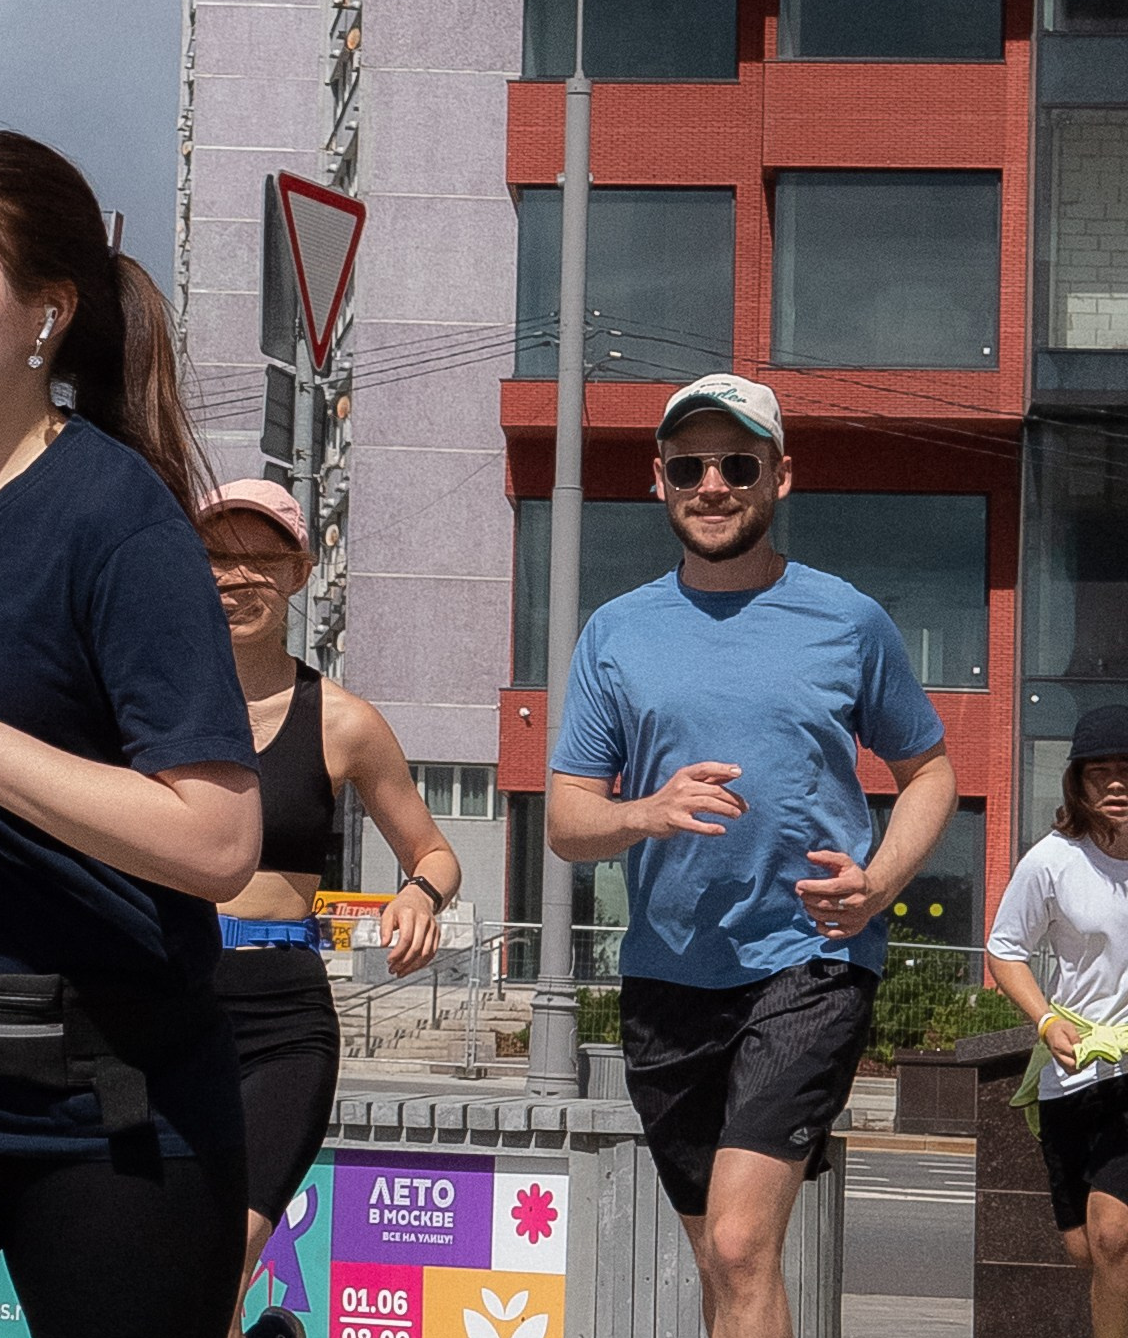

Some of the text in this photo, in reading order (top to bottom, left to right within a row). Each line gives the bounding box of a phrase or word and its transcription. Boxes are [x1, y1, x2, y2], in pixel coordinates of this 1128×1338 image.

[369, 1177, 455, 1208] ЛЕТО
[369, 1208, 454, 1228] В МОСКВЕ
[382, 1232, 453, 1245] ВСЕ НА УЛИЦУ!
[342, 1287, 408, 1315] 01.06
